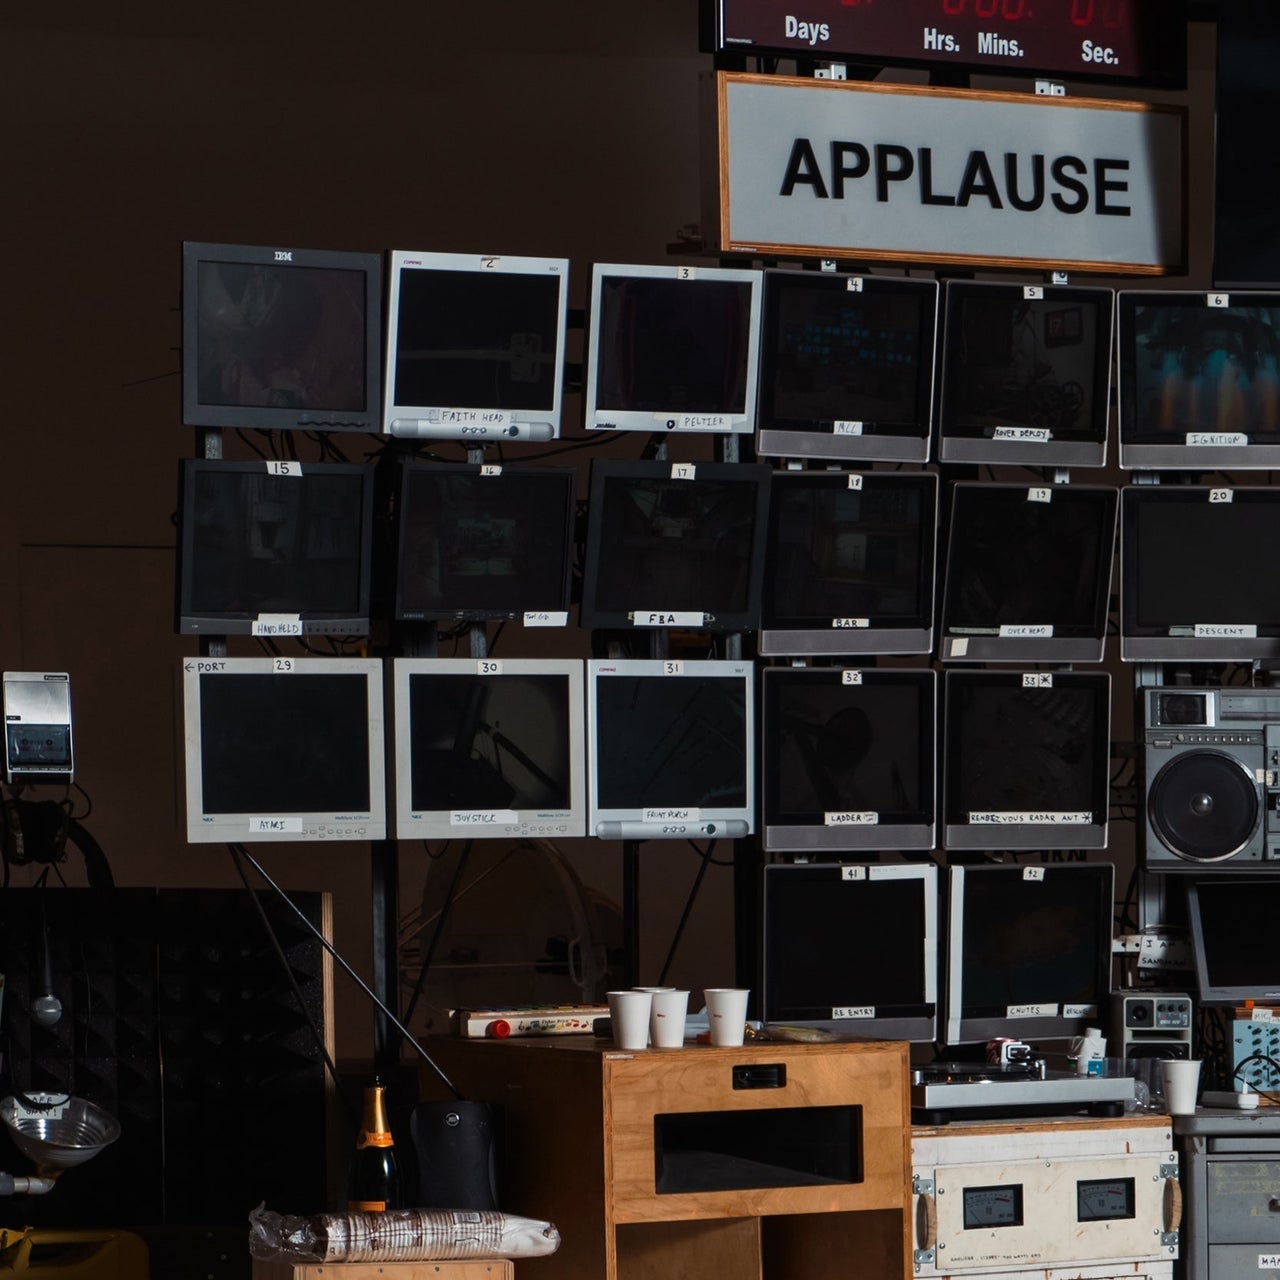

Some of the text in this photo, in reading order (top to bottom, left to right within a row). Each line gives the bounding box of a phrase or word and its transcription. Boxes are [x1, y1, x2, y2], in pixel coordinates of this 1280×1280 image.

[785, 16, 1119, 65] Days Hrs. Mins. Sec.
[780, 137, 1132, 216] APPLAUSE
[275, 251, 292, 261] IBM
[682, 269, 689, 278] 3
[1028, 288, 1035, 296] 5
[1214, 296, 1221, 304] 6
[443, 411, 504, 422] FAITH HEAD
[685, 417, 724, 427] PELTIER
[995, 429, 1046, 439] ROVER DEPLOY
[1191, 434, 1241, 445] IGNITION
[274, 462, 290, 475] 15
[485, 467, 495, 475] 16
[677, 468, 688, 478] 17
[1035, 491, 1046, 499] 19
[1213, 492, 1227, 500] 20
[1199, 627, 1244, 635] DESCENT
[198, 663, 227, 671] PORT
[276, 660, 291, 671] 29
[482, 662, 497, 673] 30
[667, 662, 679, 674] 31
[846, 672, 858, 682] 32
[1024, 676, 1035, 686] 33
[454, 813, 497, 823] JOYSTICK
[831, 814, 861, 823] LADDER
[1029, 813, 1079, 822] RADAR ANT
[259, 820, 285, 829] ATARI
[847, 869, 858, 879] 41
[1028, 869, 1038, 877] 42
[849, 1008, 873, 1017] ENTRY
